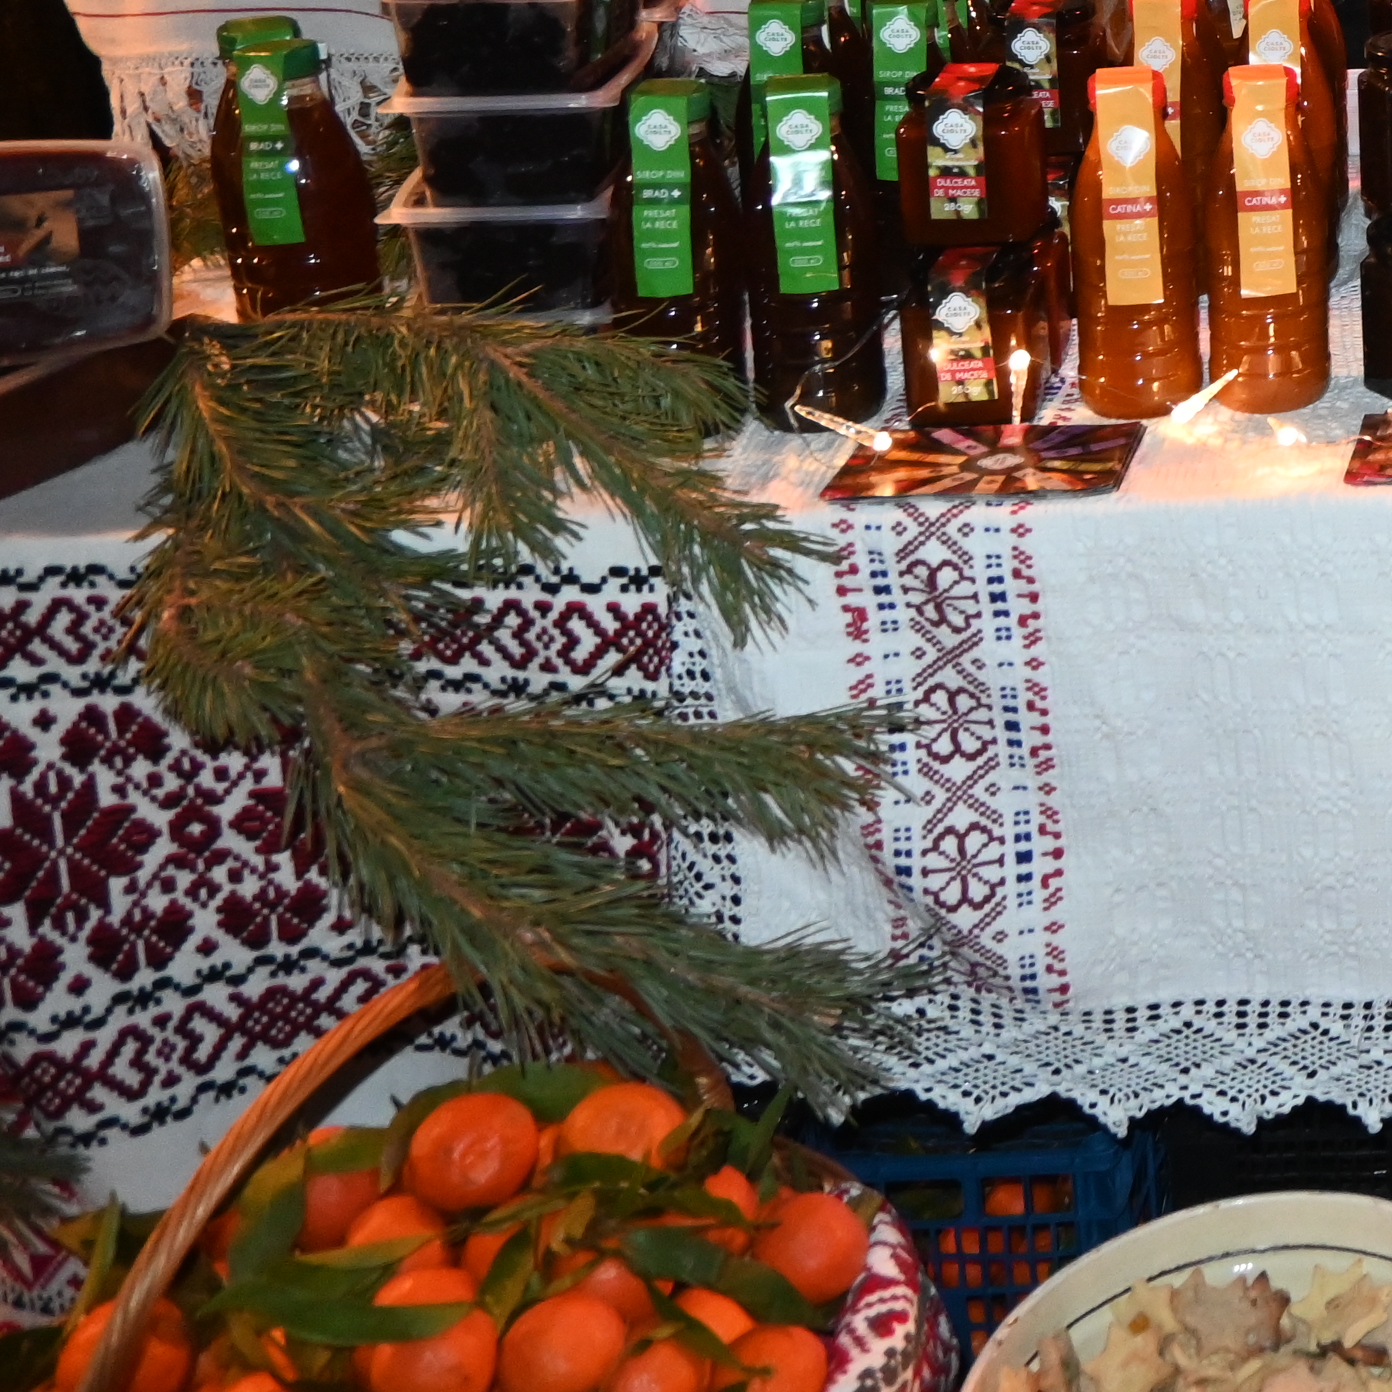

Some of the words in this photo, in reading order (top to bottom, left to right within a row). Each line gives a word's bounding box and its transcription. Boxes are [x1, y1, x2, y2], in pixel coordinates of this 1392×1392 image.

[642, 189, 668, 198] BRAD
[1245, 197, 1276, 206] CATINA
[1109, 204, 1142, 213] CATINA
[644, 209, 675, 217] PRESAT
[799, 219, 821, 227] RECE
[1252, 215, 1280, 223] PRESAT
[1263, 225, 1283, 233] RECE
